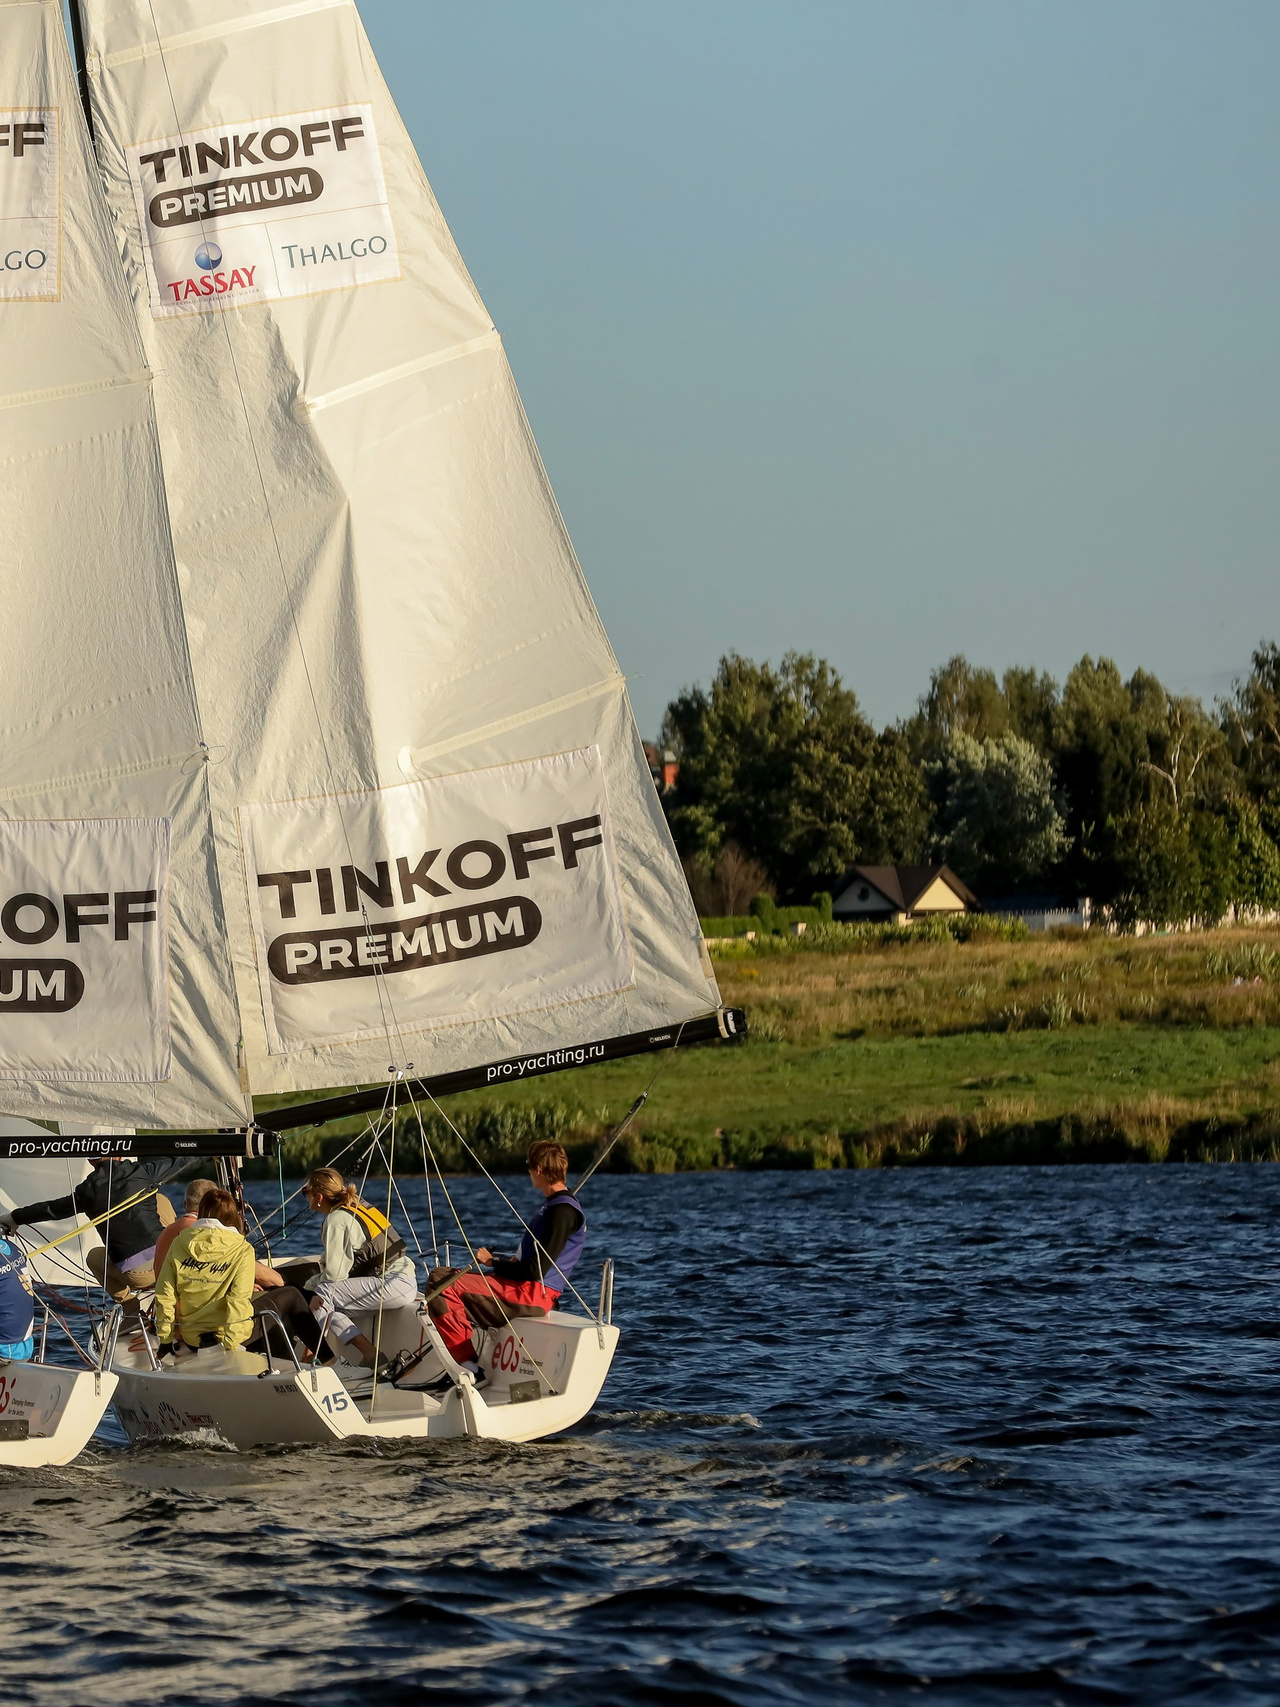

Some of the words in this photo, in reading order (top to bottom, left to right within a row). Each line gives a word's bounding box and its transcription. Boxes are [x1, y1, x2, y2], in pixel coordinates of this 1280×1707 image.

[140, 116, 364, 184] TINKOFF
[160, 174, 312, 222] PREMIUM
[167, 265, 256, 302] TASSAY
[258, 814, 603, 919] TINKOFF
[284, 906, 526, 976] PREMIUM
[486, 1044, 606, 1081] pro-yachting.ru
[8, 1137, 133, 1157] pro-yachting.ru
[321, 1391, 348, 1414] 15
